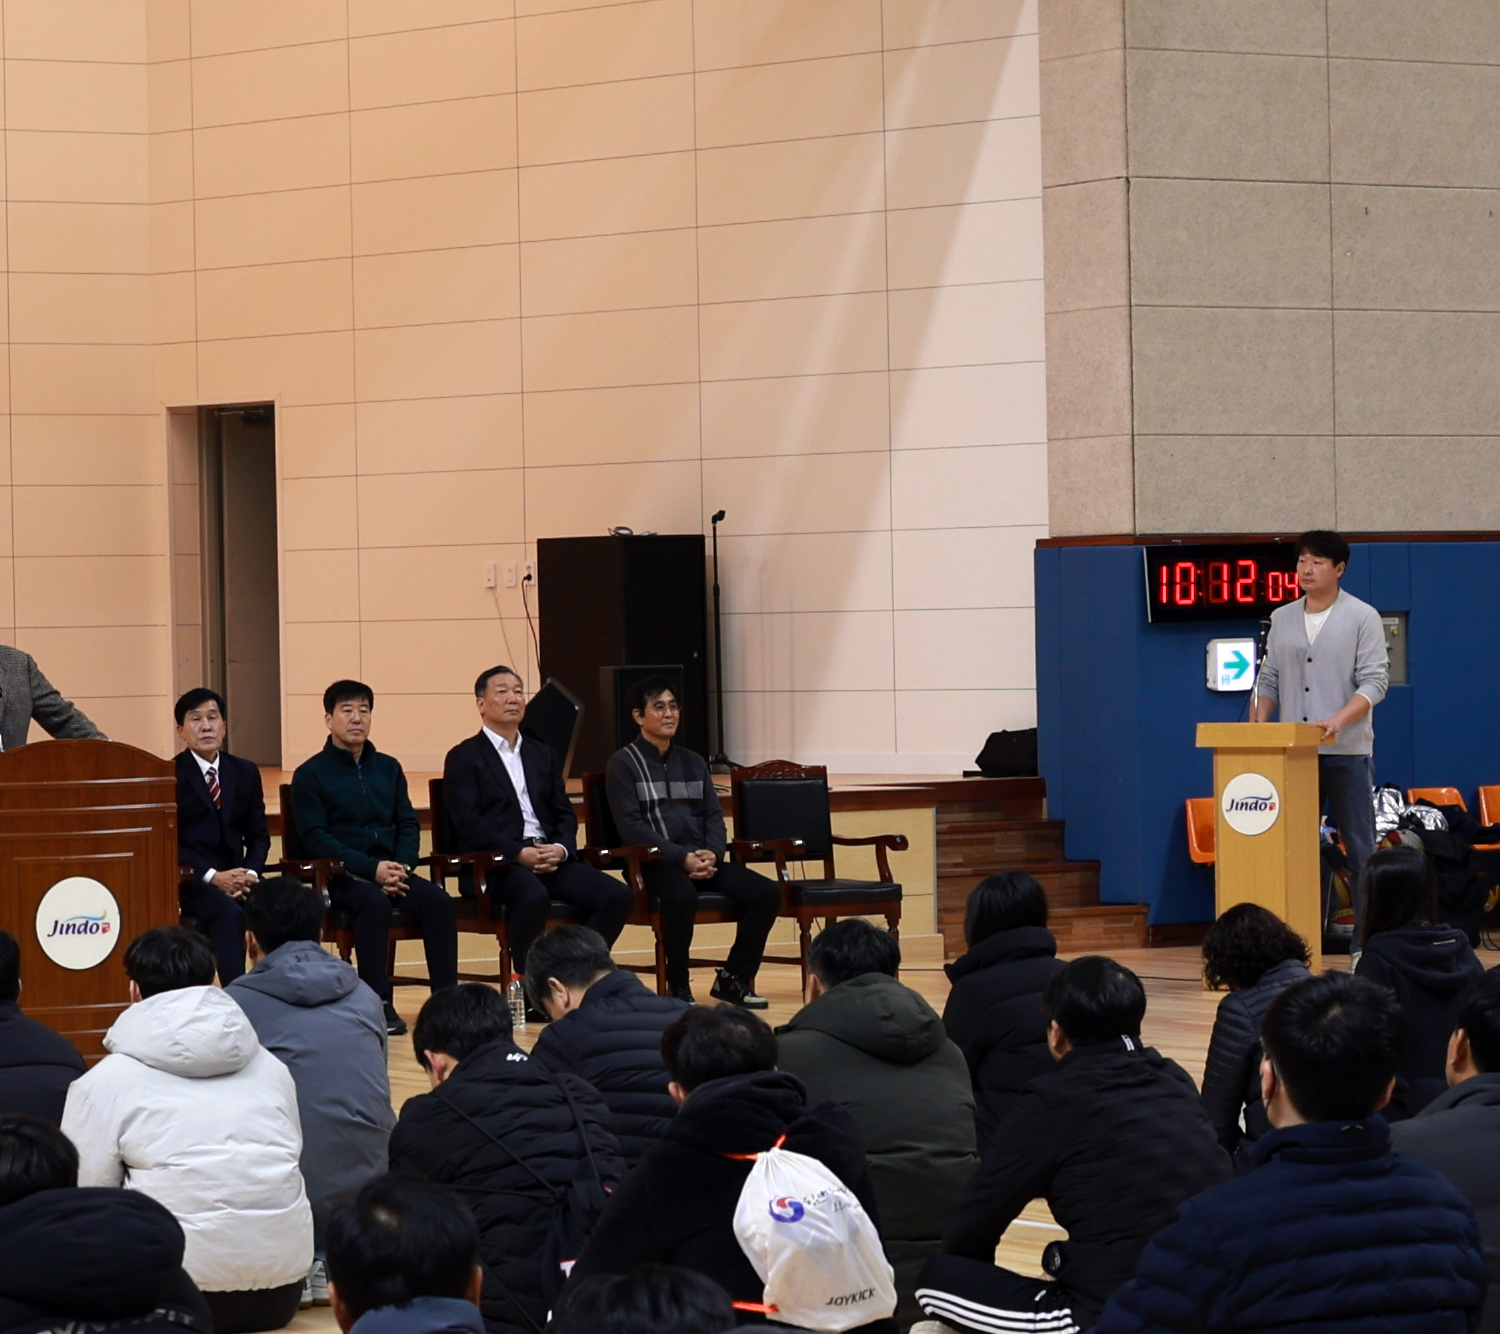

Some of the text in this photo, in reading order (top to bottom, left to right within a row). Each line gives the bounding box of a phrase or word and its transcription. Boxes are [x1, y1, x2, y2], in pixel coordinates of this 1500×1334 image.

[1225, 798, 1267, 812] Jindo
[46, 919, 100, 938] Jindo
[825, 1287, 876, 1306] JOYKICK
